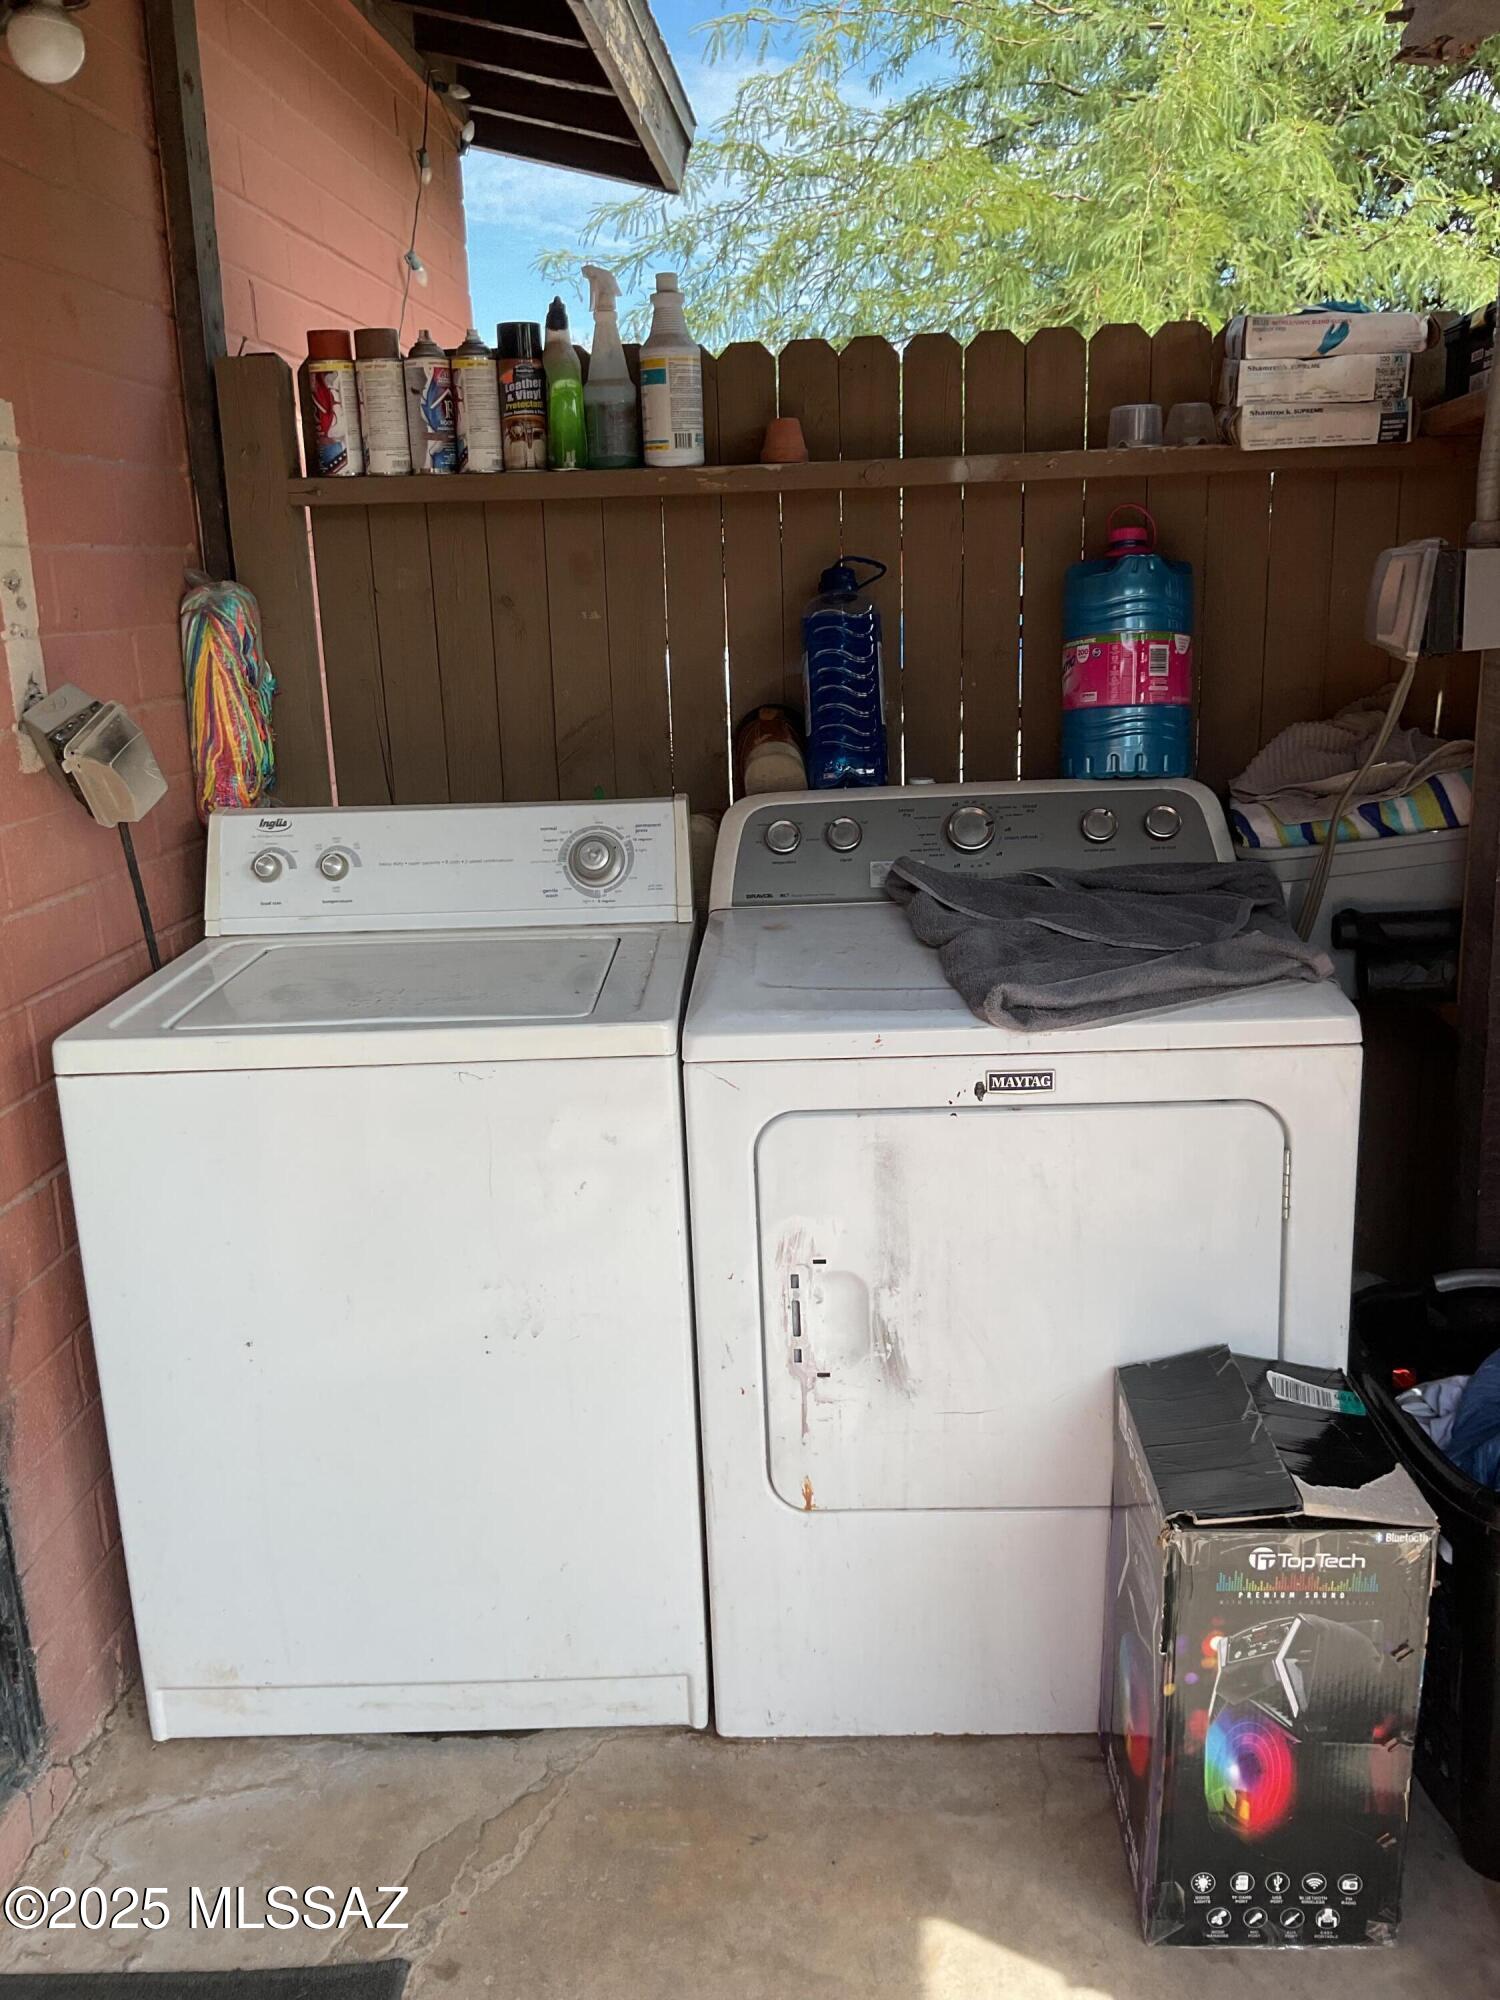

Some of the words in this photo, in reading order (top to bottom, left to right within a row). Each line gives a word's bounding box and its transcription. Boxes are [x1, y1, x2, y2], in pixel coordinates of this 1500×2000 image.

[505, 378, 542, 394] Leather
[515, 389, 542, 401] Vinyl
[1249, 408, 1291, 417] Shamrock
[1293, 407, 1324, 415] SUPREME
[259, 818, 288, 830] Inglis
[991, 1075, 1052, 1088] MAYTAG
[1385, 1533, 1430, 1544] Bluetooth
[1277, 1552, 1366, 1572] TopTech
[1238, 1591, 1296, 1599] PREMIUM
[1305, 1591, 1346, 1599] SOUND
